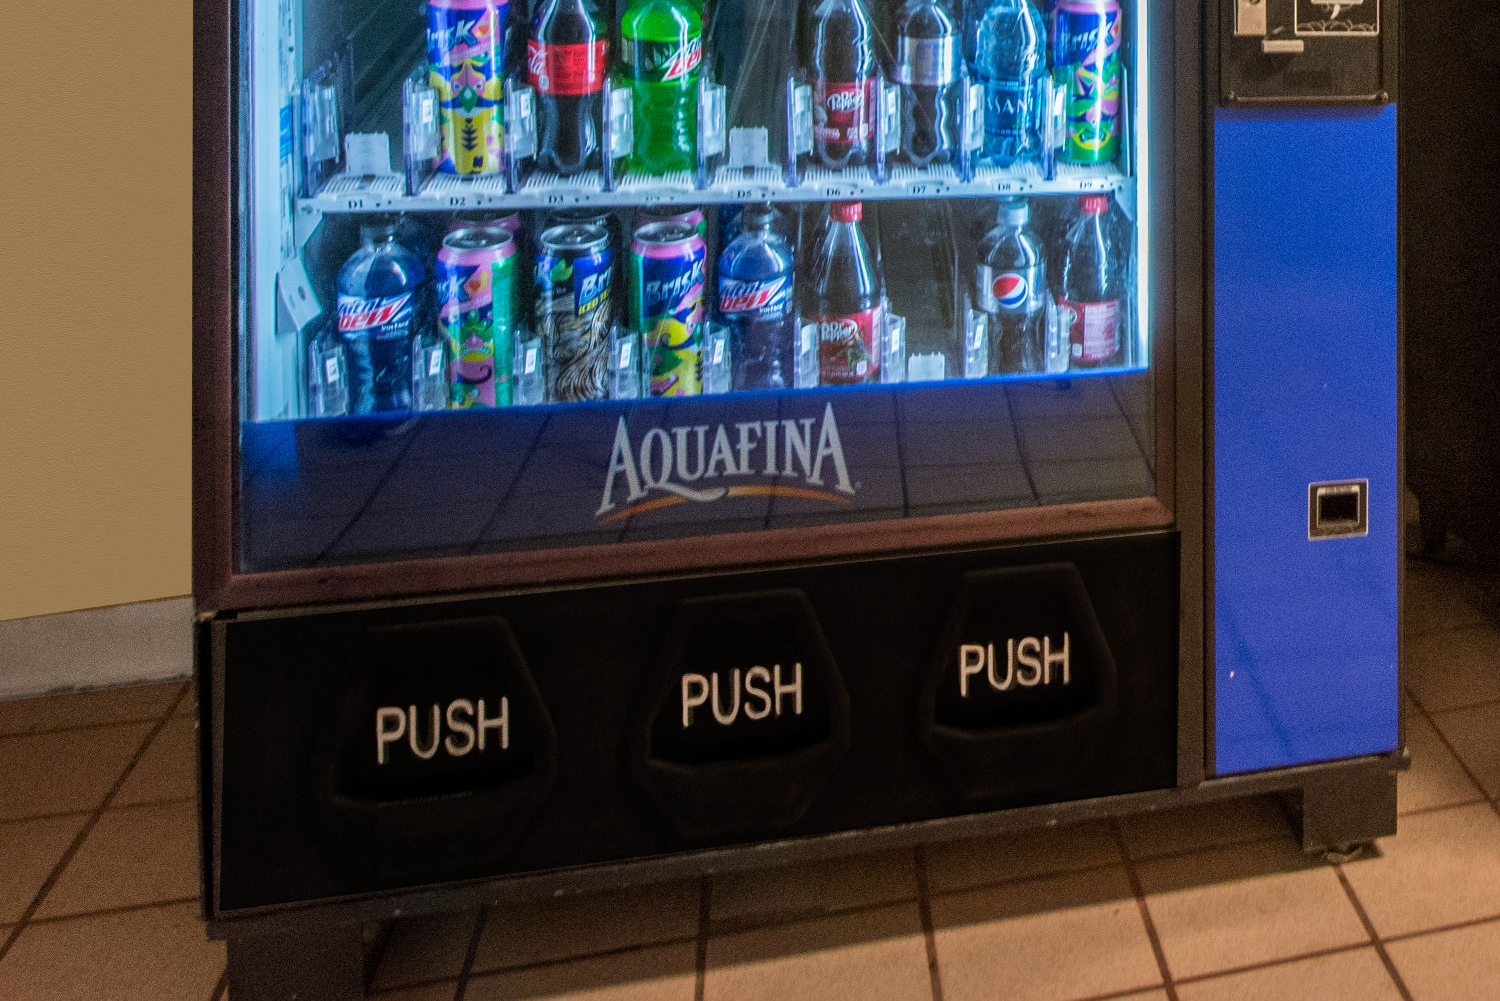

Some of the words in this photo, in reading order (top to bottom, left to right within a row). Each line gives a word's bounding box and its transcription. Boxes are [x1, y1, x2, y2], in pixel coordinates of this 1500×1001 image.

[912, 185, 926, 194] D7
[997, 183, 1011, 191] D8
[737, 189, 752, 198] D5
[826, 188, 840, 196] D6
[348, 200, 364, 209] D1
[450, 197, 466, 206] D2
[595, 401, 855, 516] AQUAFINA
[959, 631, 1072, 698] PUSH
[682, 662, 803, 730] PUSH
[376, 697, 510, 765] PUSH
